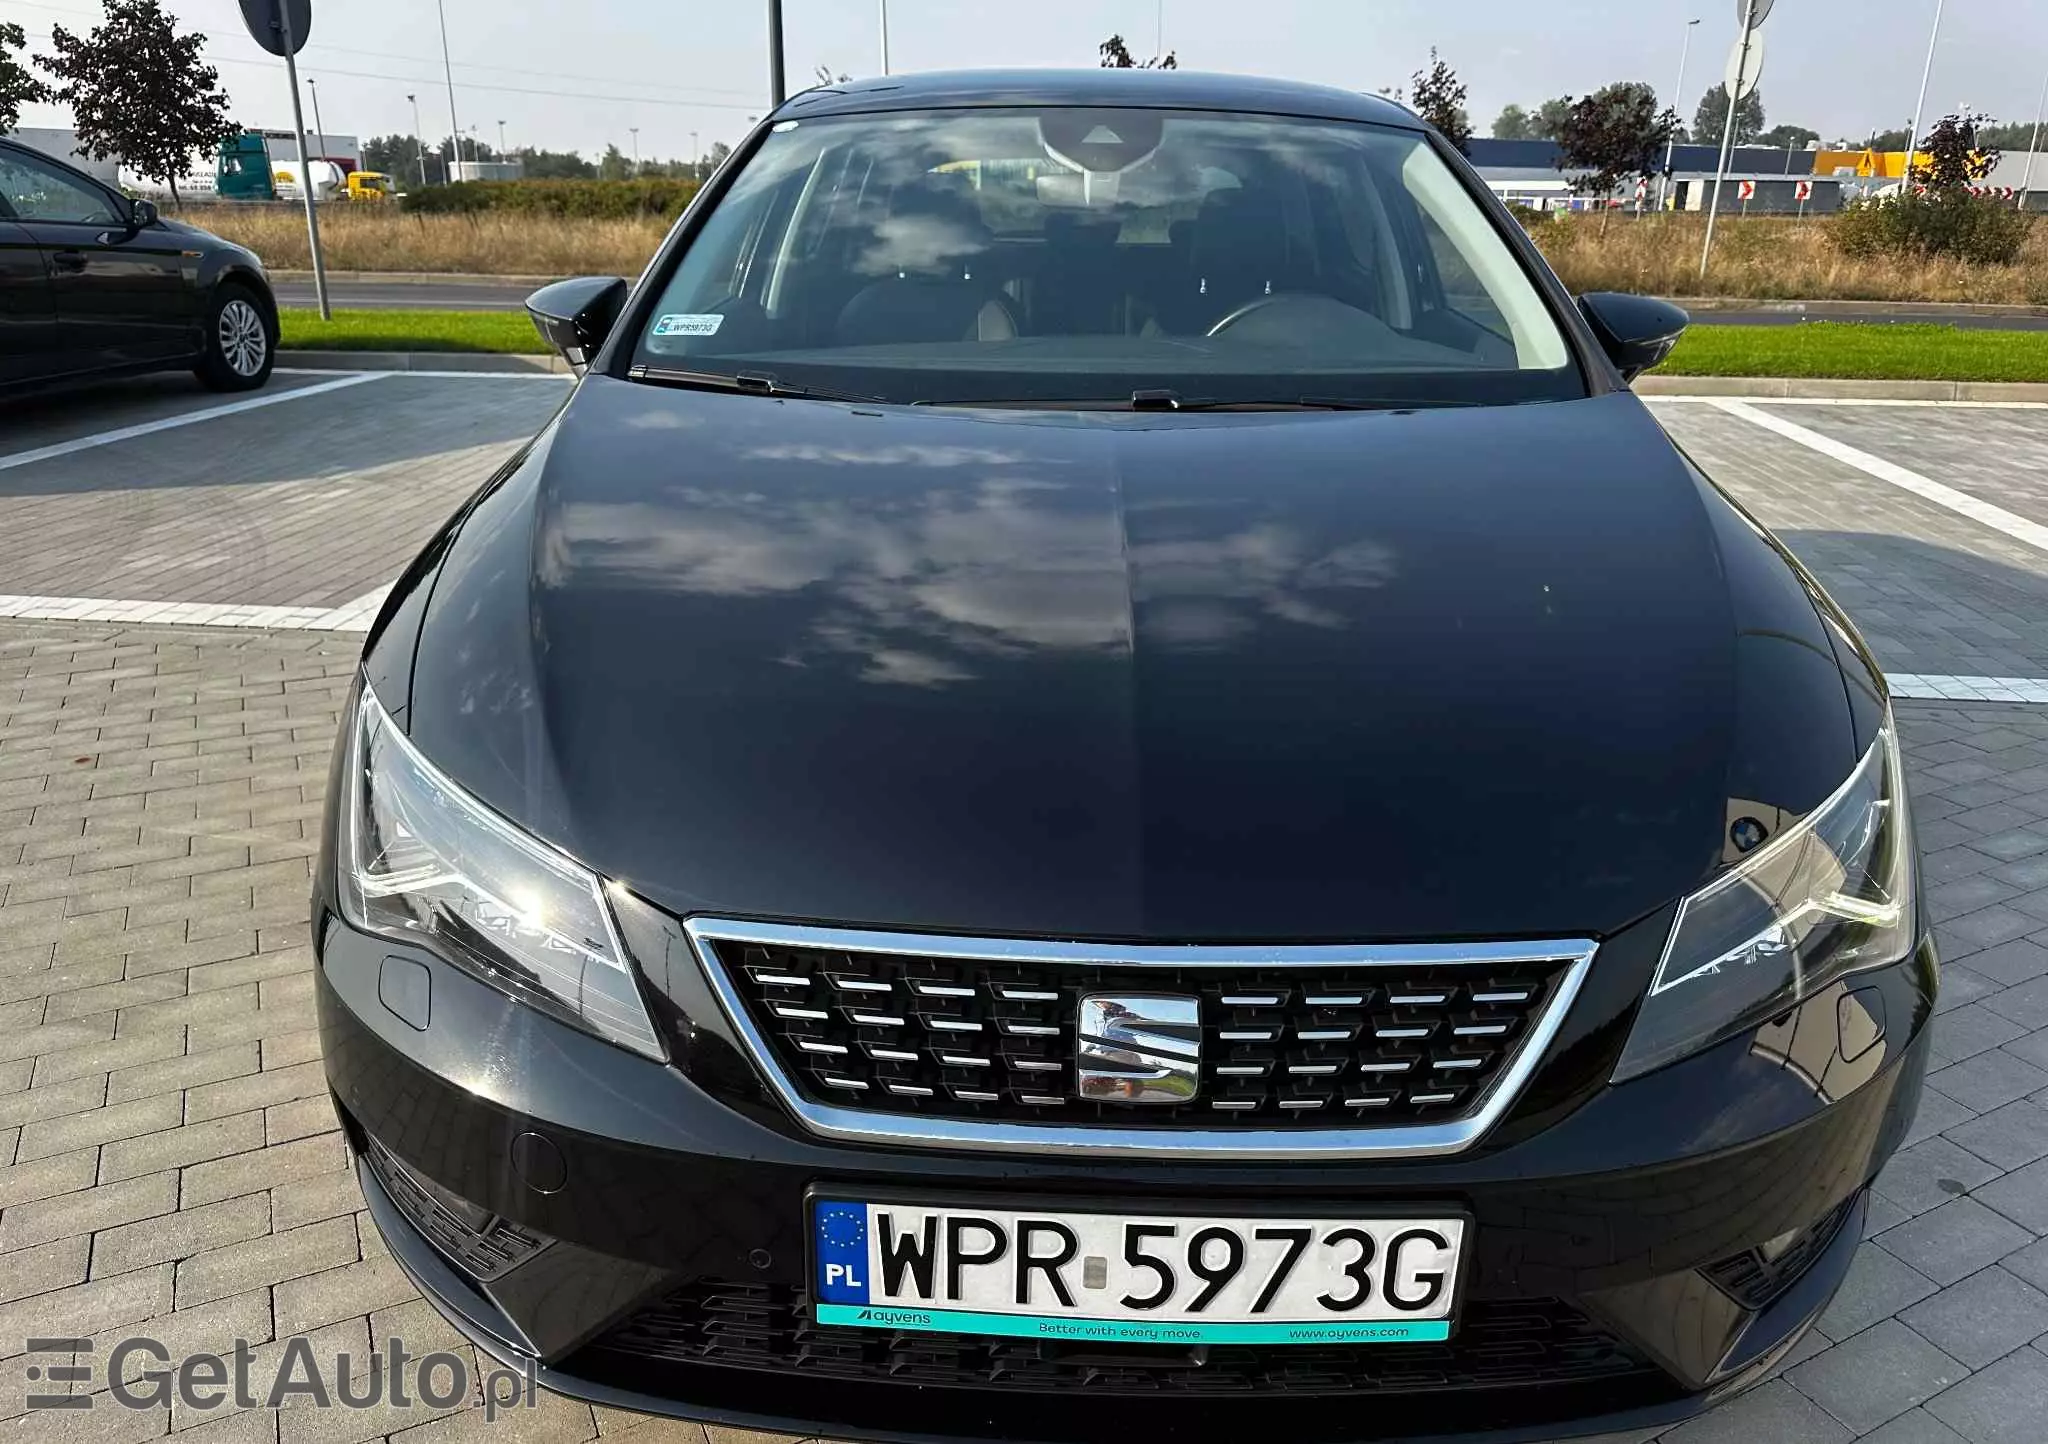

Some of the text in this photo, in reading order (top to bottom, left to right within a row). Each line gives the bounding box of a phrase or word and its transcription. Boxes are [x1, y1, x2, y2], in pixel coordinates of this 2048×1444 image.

[877, 1213, 1449, 1314] WPR 5973G
[826, 1263, 863, 1287] PL
[1039, 1321, 1081, 1335] Better
[1085, 1326, 1117, 1337] with
[1119, 1328, 1159, 1340] every
[1289, 1327, 1409, 1341] www.ayvens.com
